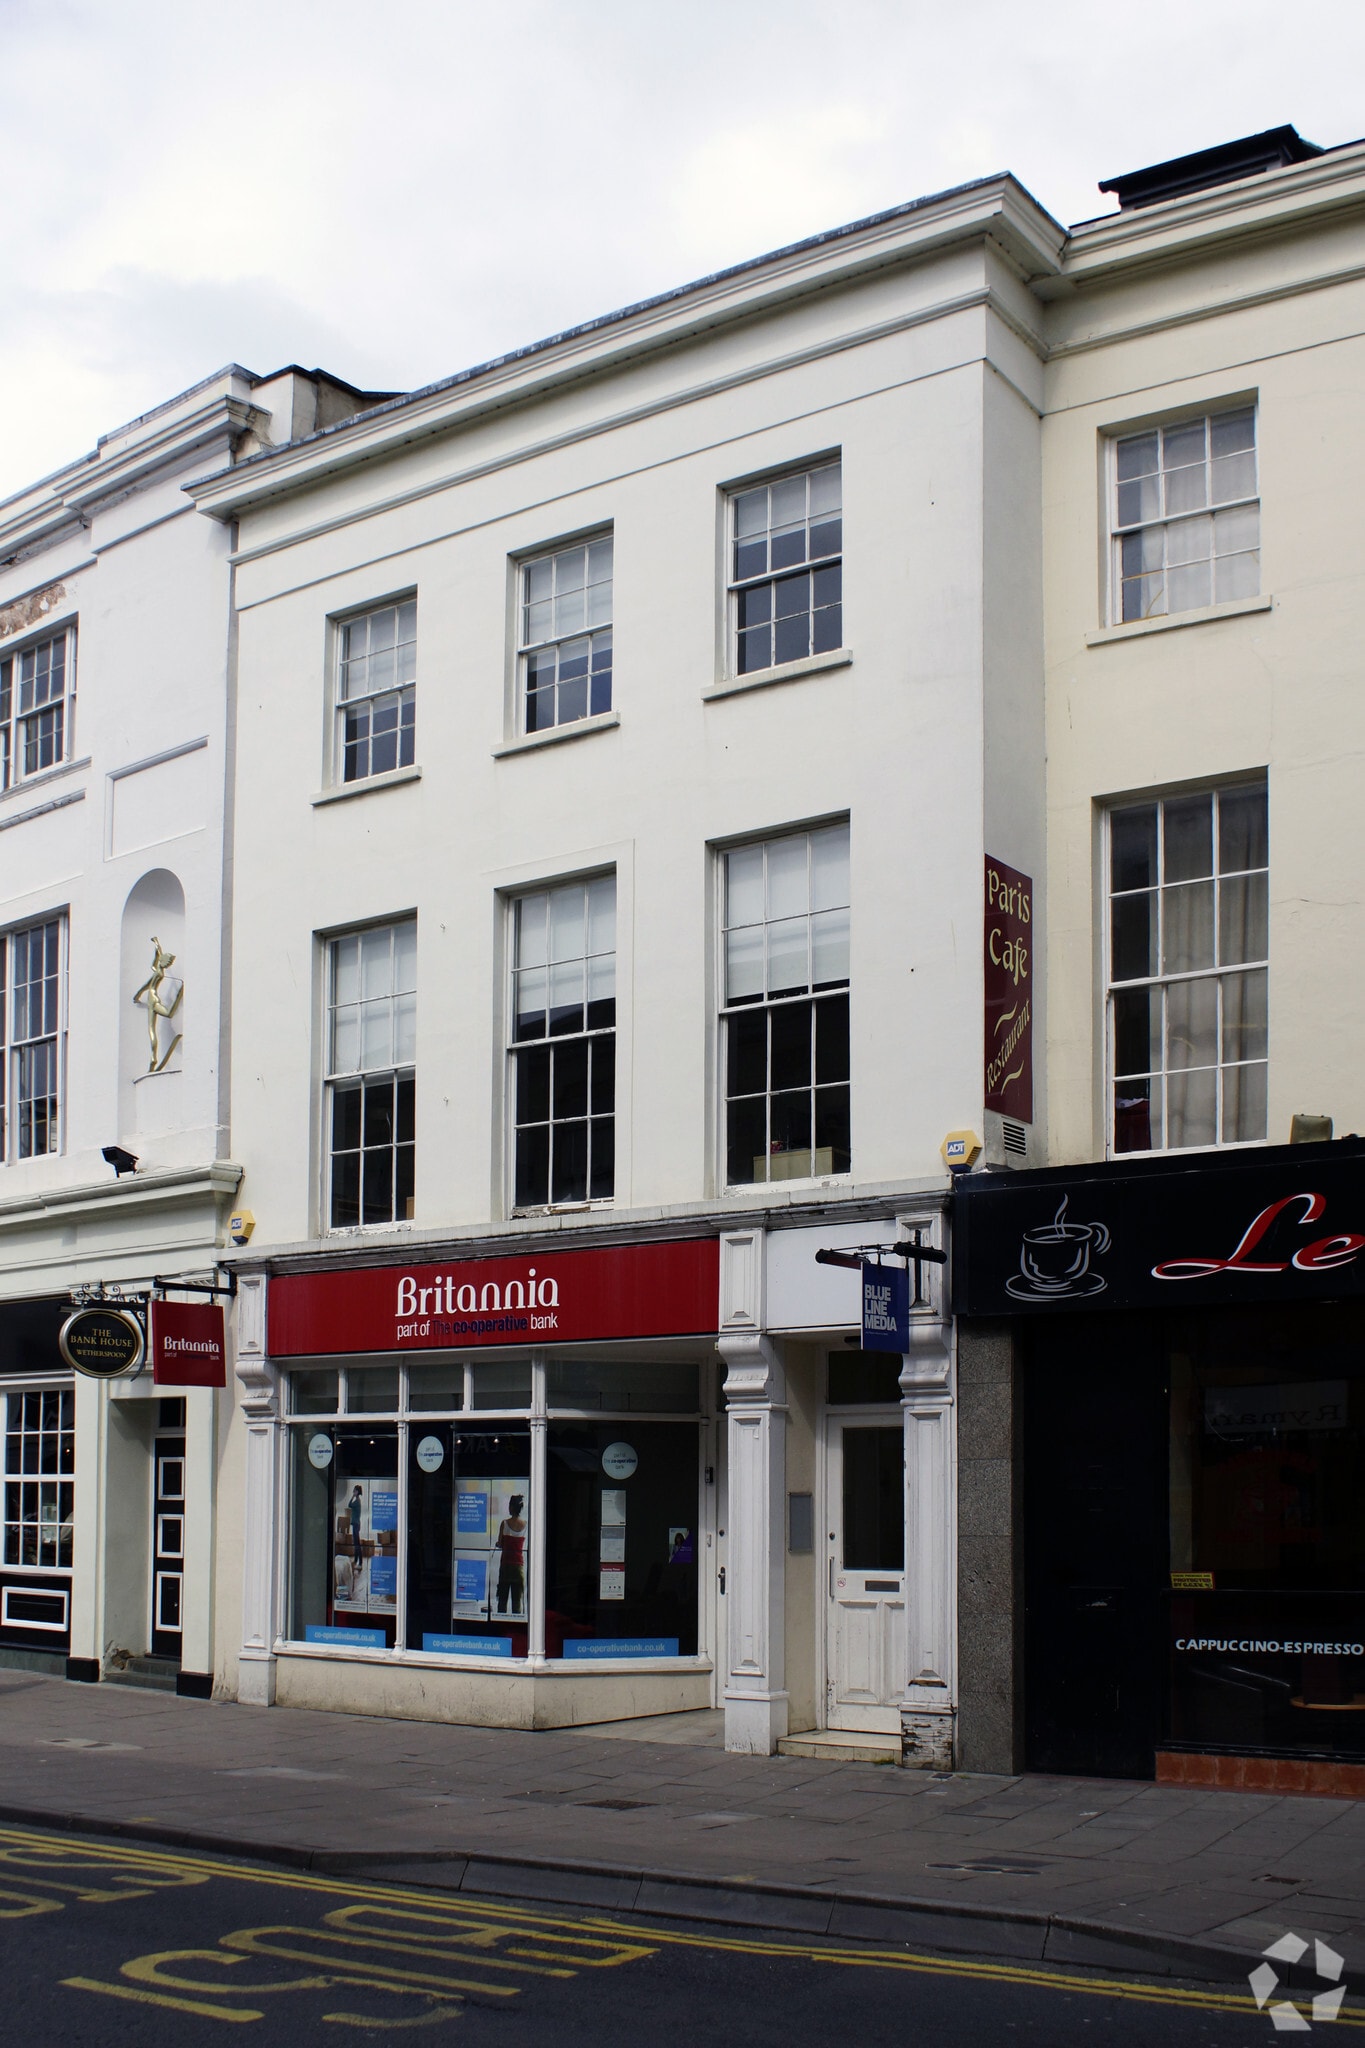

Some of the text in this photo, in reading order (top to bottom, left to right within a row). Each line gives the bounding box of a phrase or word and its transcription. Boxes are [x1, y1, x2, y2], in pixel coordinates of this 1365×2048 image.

[986, 868, 1030, 924] Paris
[988, 927, 1028, 986] Cafe
[986, 998, 1030, 1094] Restaurant
[947, 1142, 965, 1154] ADT
[1150, 1192, 1365, 1280] Le
[394, 1267, 560, 1318] Britannia
[864, 1283, 892, 1302] BLUE
[864, 1299, 888, 1316] LINE
[397, 1321, 418, 1341] part
[419, 1319, 431, 1336] of
[432, 1319, 450, 1335] The
[530, 1311, 559, 1330] bank
[864, 1314, 898, 1332] MEDIA
[70, 1335, 133, 1348] BANK HOUSE
[91, 1327, 112, 1338] THE
[163, 1335, 220, 1354] Britannia
[76, 1349, 127, 1359] WETHERSPOON
[314, 1630, 377, 1643] co-operativebank.co.uk
[432, 1638, 501, 1652] co-operativebank.co.uk
[577, 1642, 666, 1655] co-operativebank.co.uk
